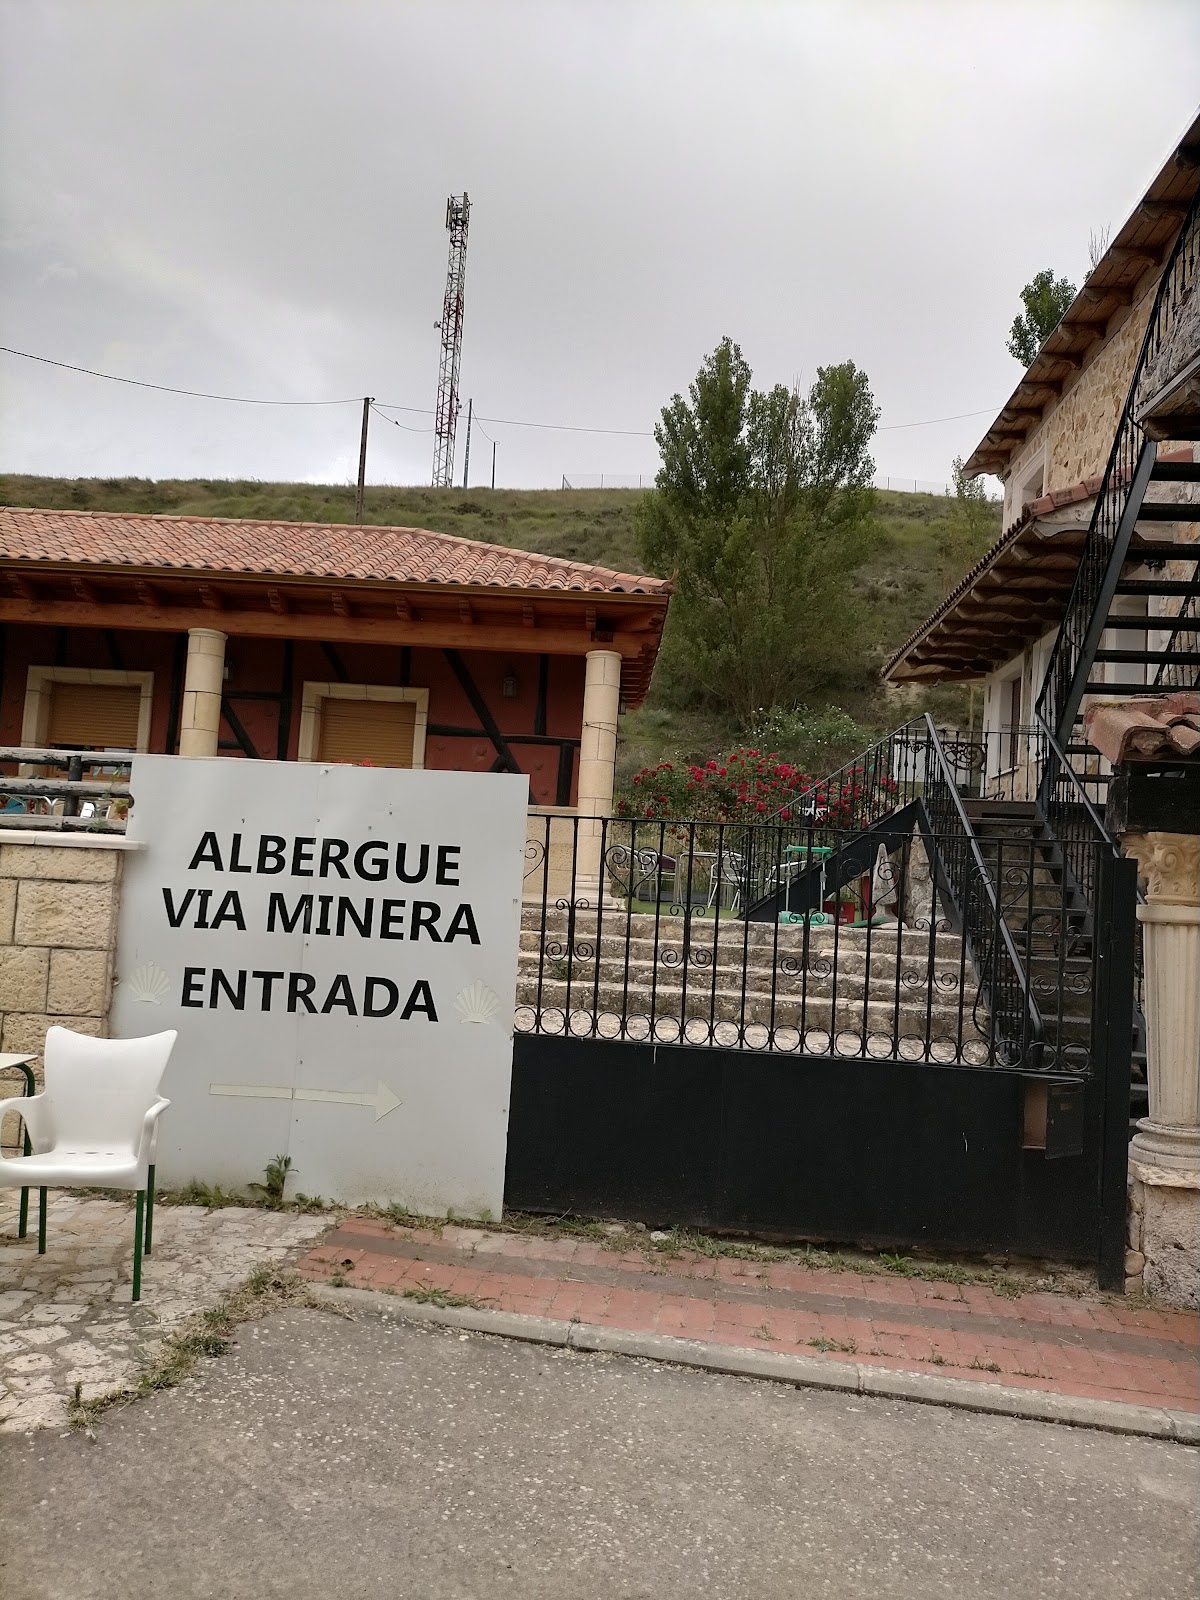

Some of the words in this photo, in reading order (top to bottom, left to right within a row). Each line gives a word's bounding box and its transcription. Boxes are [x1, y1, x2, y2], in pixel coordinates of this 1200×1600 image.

[188, 832, 461, 886] ALBERGUE
[162, 888, 247, 931] VIA
[267, 893, 482, 946] MINERA
[181, 967, 439, 1023] ENTRADA
